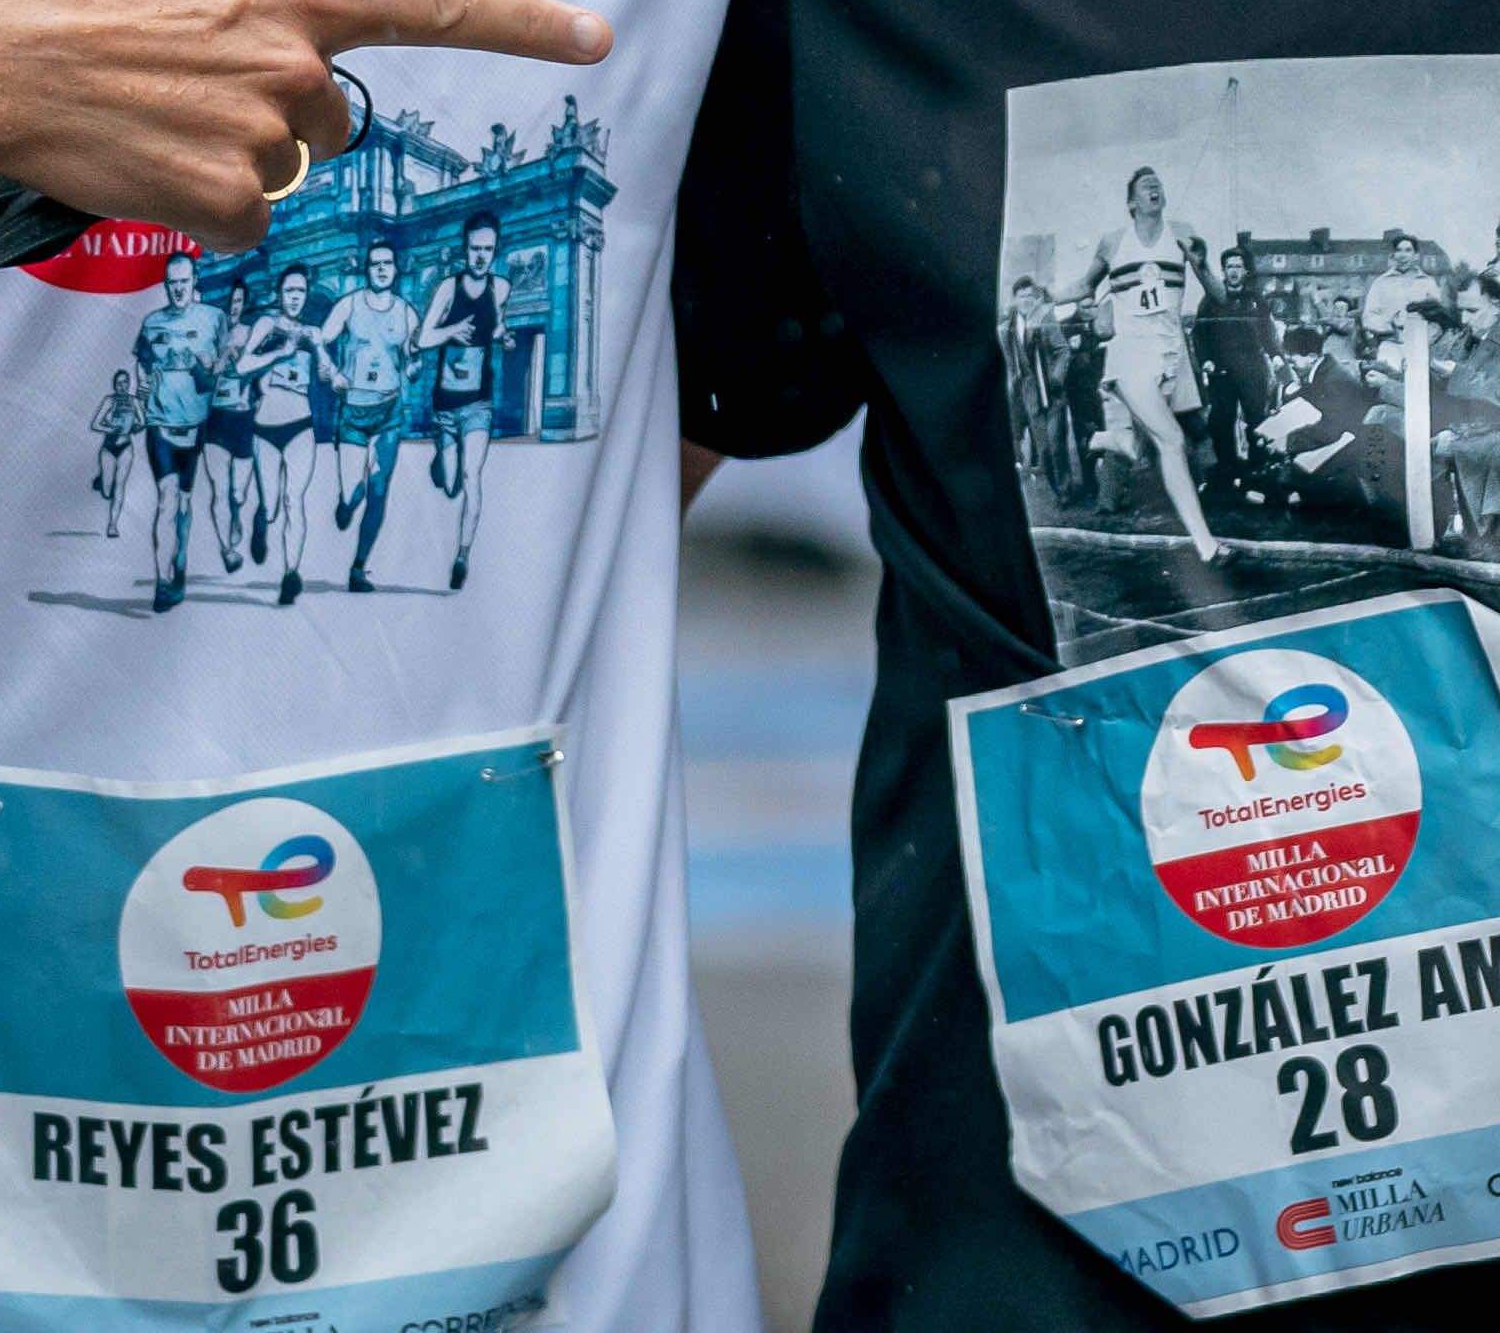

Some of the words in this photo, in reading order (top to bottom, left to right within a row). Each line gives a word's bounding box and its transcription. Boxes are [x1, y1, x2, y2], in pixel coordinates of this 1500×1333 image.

[82, 231, 197, 258] MADRID
[1140, 287, 1158, 310] 41
[1198, 783, 1366, 830] TotalEnergies
[1248, 840, 1327, 873] MILLA
[1226, 908, 1263, 932] DE
[1267, 885, 1368, 922] MADRID
[184, 933, 337, 971] TotalEnergies
[228, 988, 293, 1017] MILLA
[1098, 956, 1400, 1087] GONZÁLEZ
[197, 1051, 233, 1071] DE
[238, 1035, 322, 1068] MADRID
[1277, 1043, 1399, 1155] 28
[33, 1111, 227, 1193] REYES
[251, 1083, 489, 1188] ESTÉVEZ
[1336, 1179, 1428, 1214] MILLA
[1342, 1202, 1445, 1241] URBANA
[215, 1188, 319, 1294] 36
